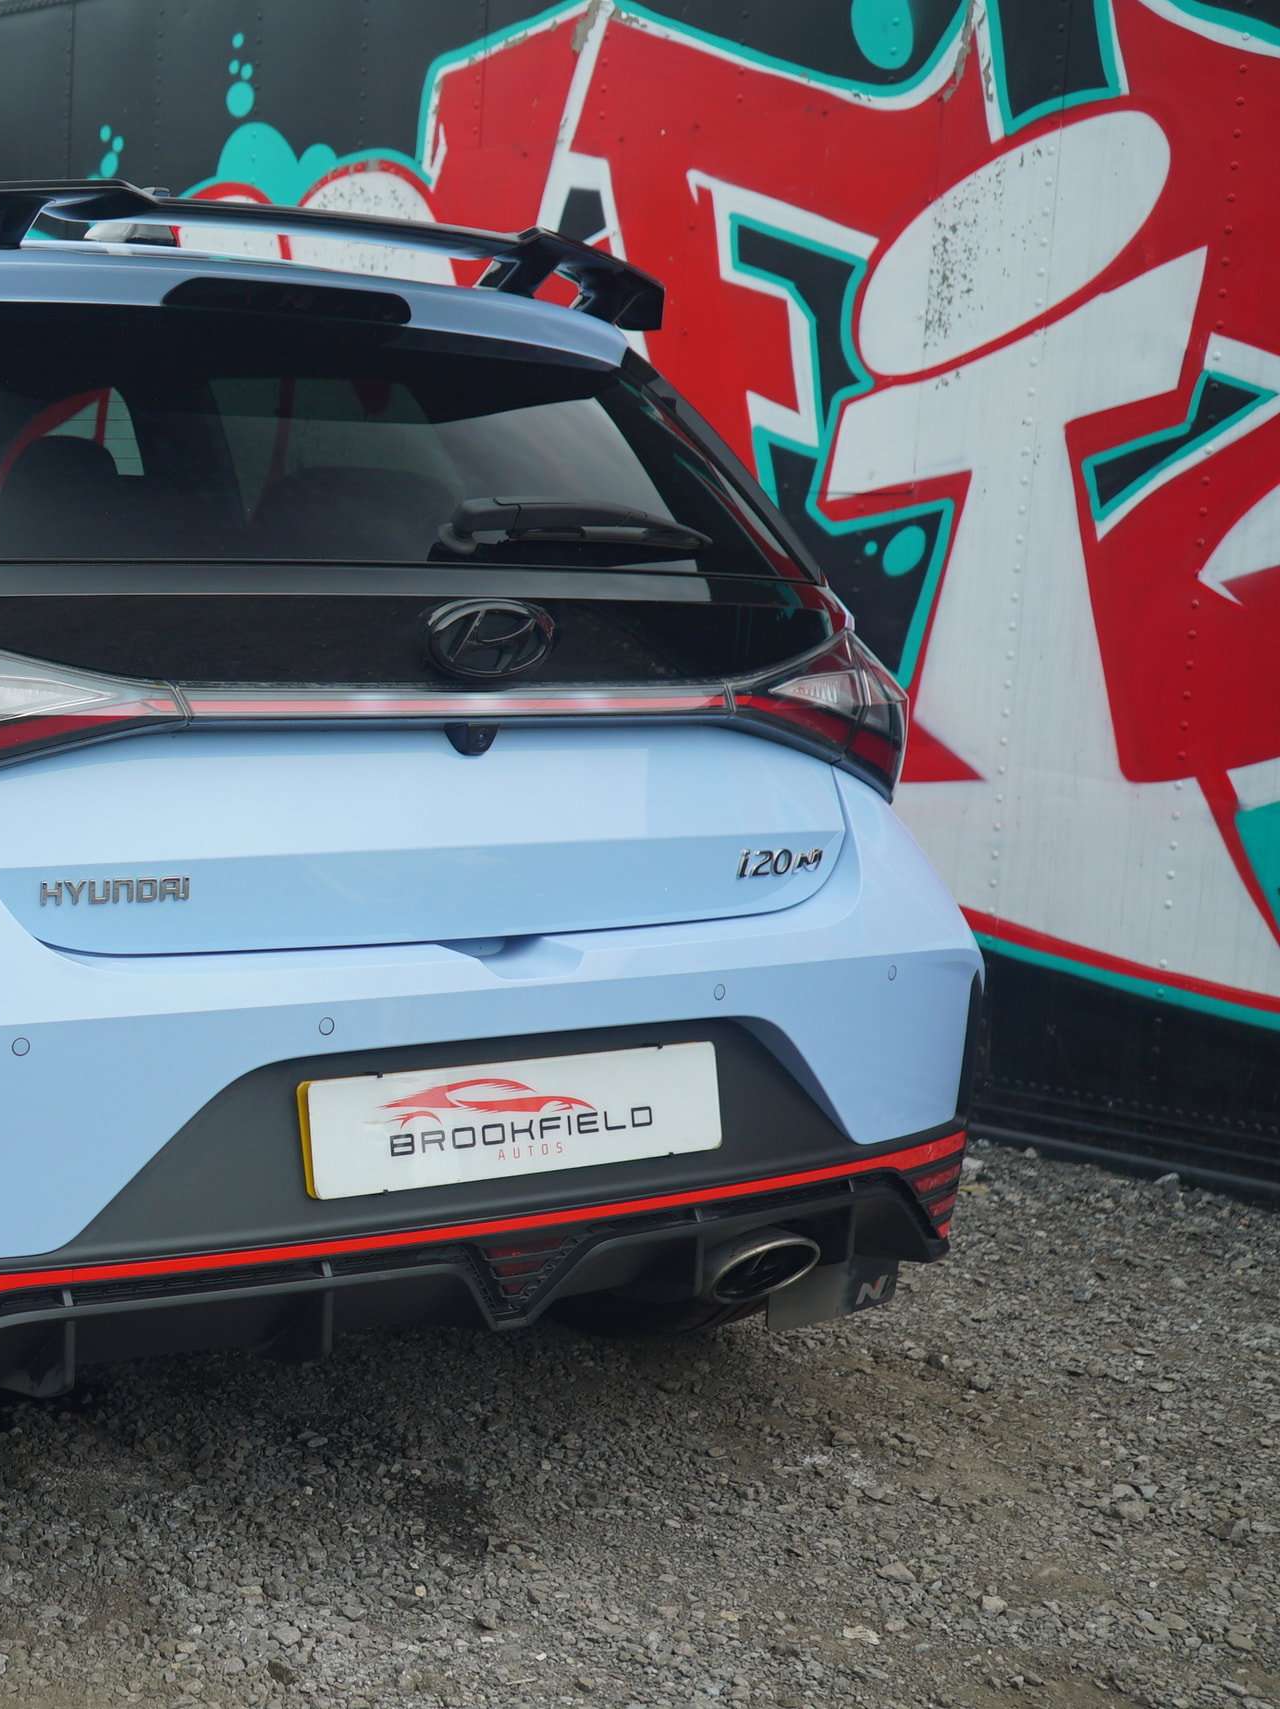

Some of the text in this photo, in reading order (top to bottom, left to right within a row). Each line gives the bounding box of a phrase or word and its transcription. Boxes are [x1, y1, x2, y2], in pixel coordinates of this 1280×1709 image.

[39, 876, 191, 907] HYUNDAI
[389, 1105, 653, 1157] BROOKFIELD
[497, 1141, 564, 1161] AUTOS
